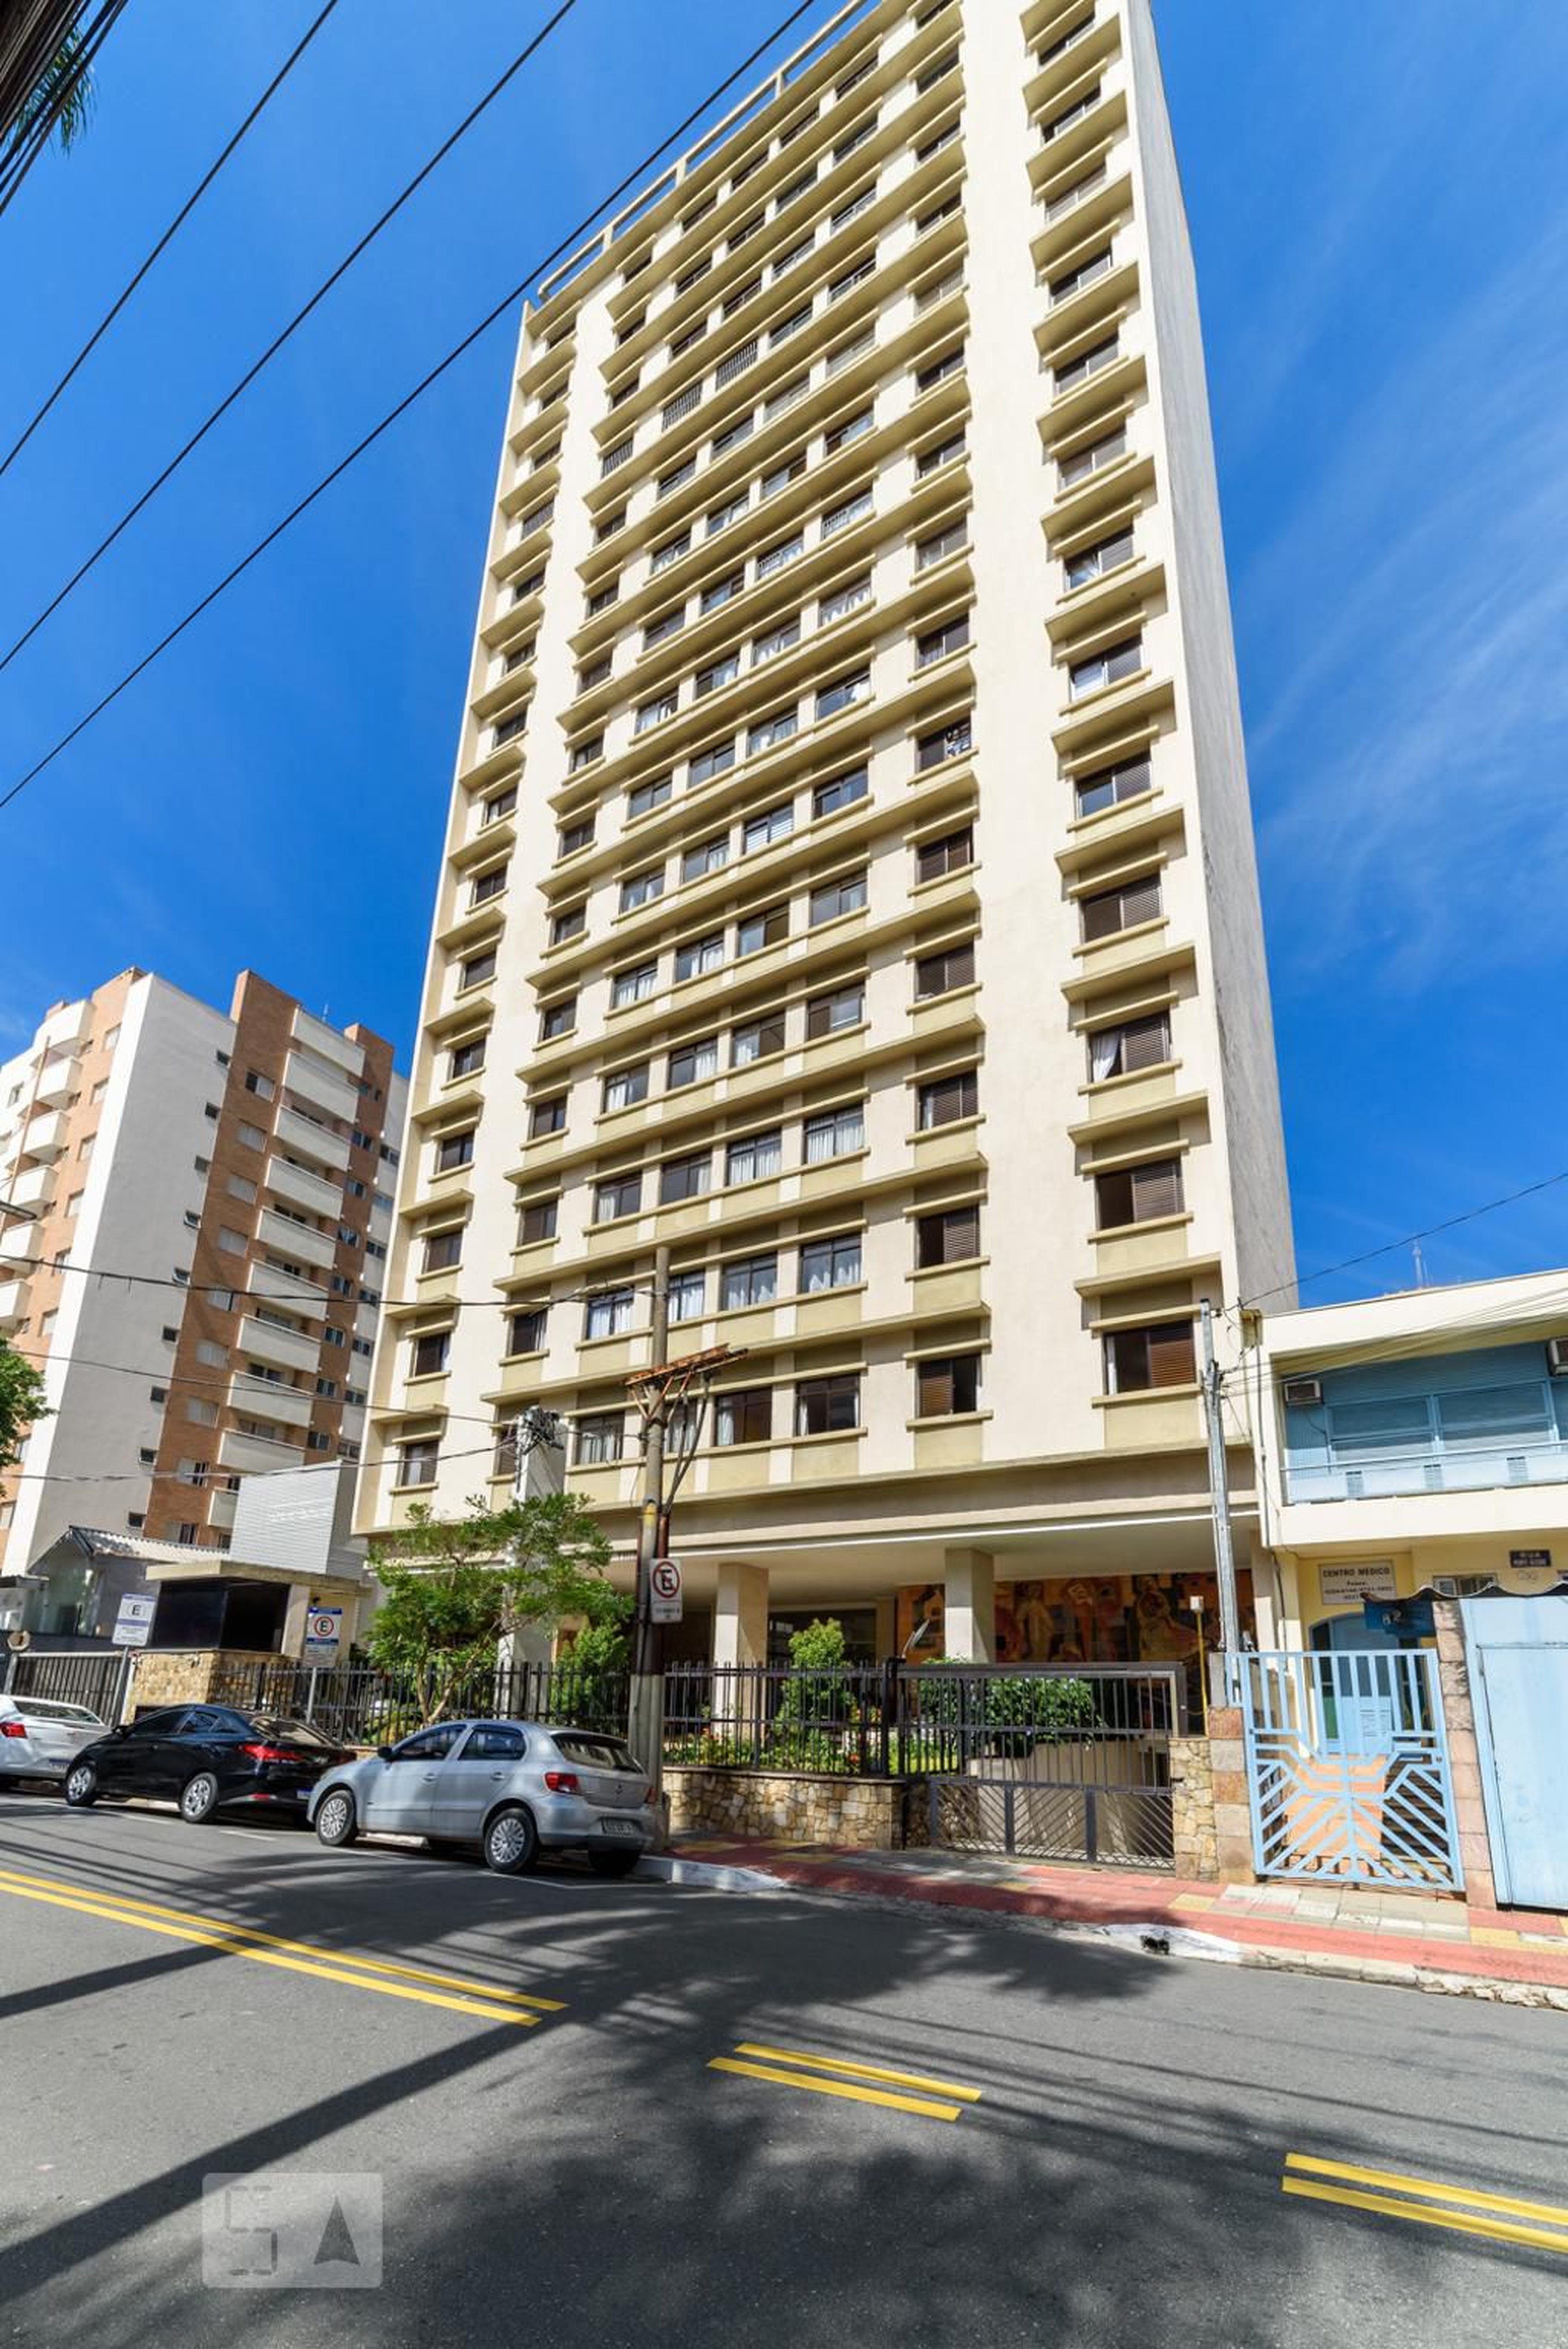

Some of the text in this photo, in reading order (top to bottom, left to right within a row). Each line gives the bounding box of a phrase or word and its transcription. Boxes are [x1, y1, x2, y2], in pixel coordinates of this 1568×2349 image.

[1323, 1569, 1355, 1577] CENTRO
[131, 1604, 141, 1616] E
[320, 1619, 328, 1632] E
